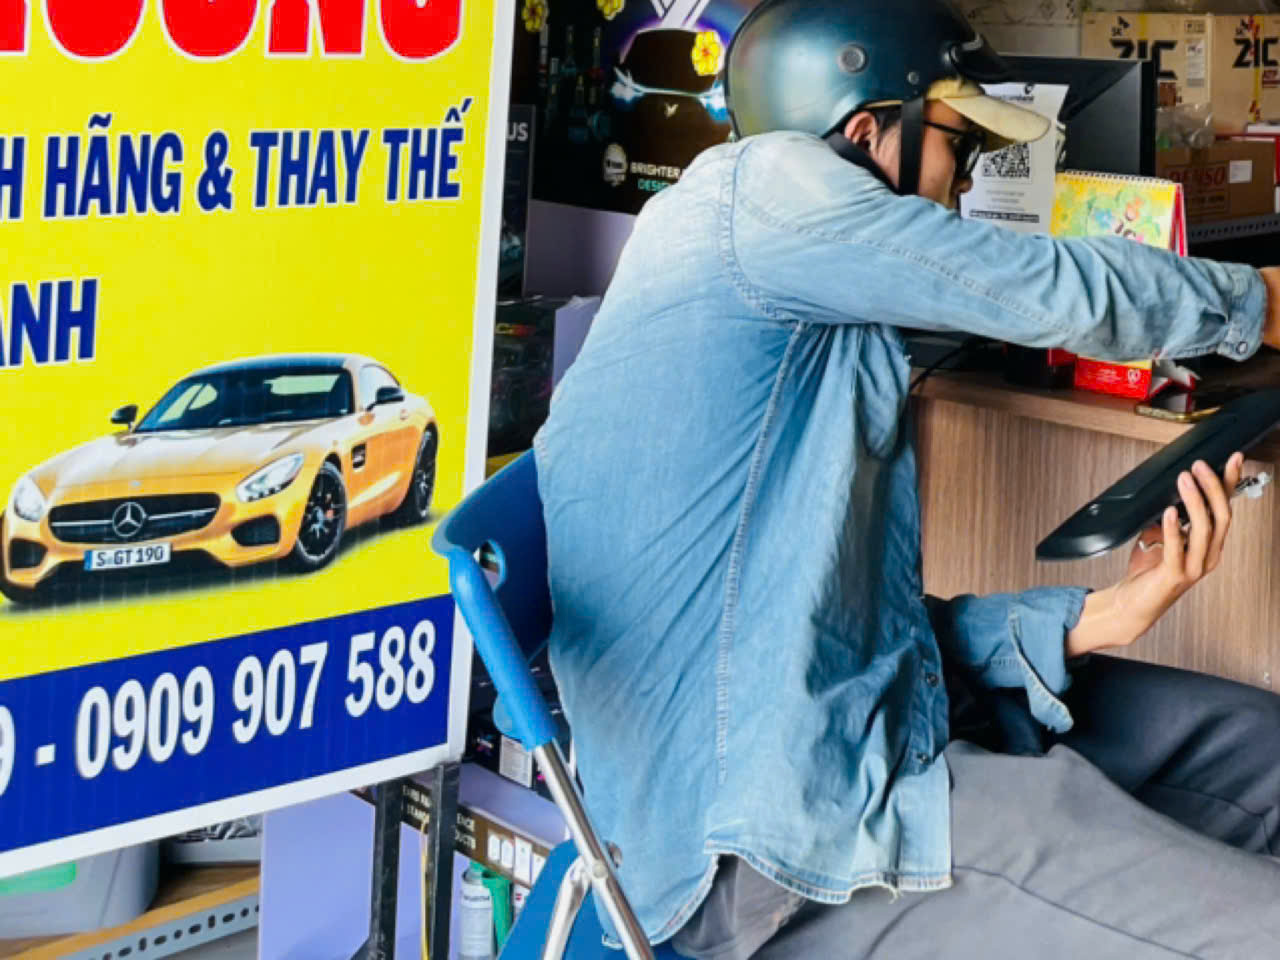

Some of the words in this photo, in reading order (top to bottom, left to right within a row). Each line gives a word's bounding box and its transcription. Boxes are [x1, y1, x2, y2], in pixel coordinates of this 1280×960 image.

[1232, 37, 1280, 69] ZIC
[44, 112, 183, 218] HÃNG
[198, 130, 233, 211] &
[250, 128, 370, 209] THAY
[382, 97, 473, 201] THẾ
[630, 161, 681, 179] BRIGHTER
[0, 279, 97, 367] NH
[114, 549, 133, 565] GT
[135, 545, 165, 563] 190
[76, 665, 214, 779] 0909
[233, 642, 328, 744] 907
[345, 619, 437, 718] 588
